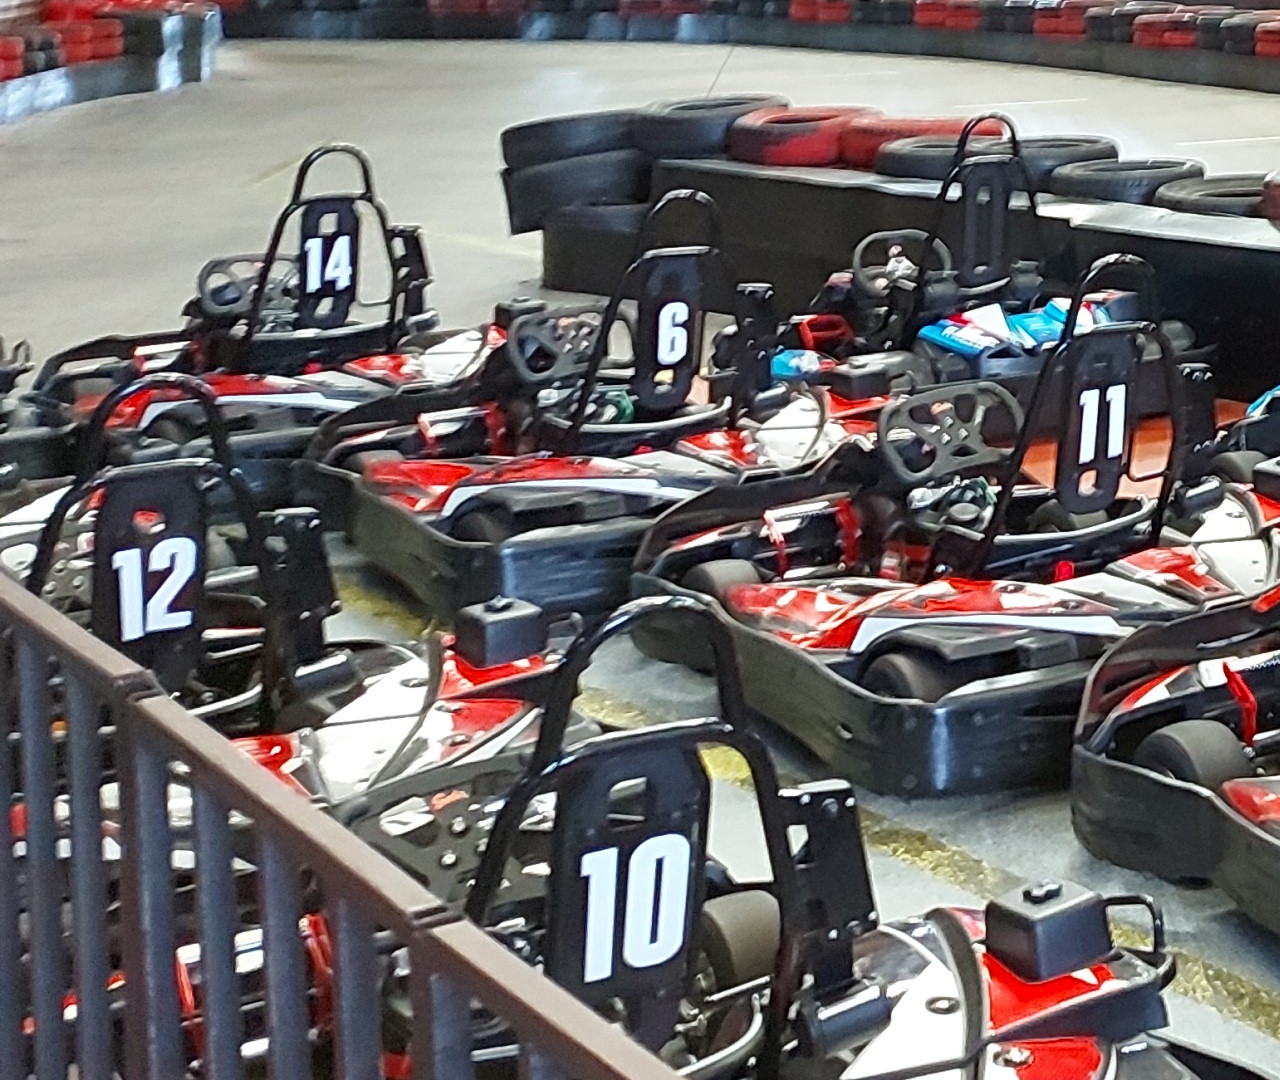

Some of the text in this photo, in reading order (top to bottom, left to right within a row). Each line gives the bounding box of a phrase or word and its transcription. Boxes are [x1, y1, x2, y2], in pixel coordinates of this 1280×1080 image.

[304, 236, 352, 293] 14
[658, 302, 688, 364] 6
[1080, 385, 1126, 463] 11
[112, 537, 196, 641] 12
[580, 834, 690, 982] 10
